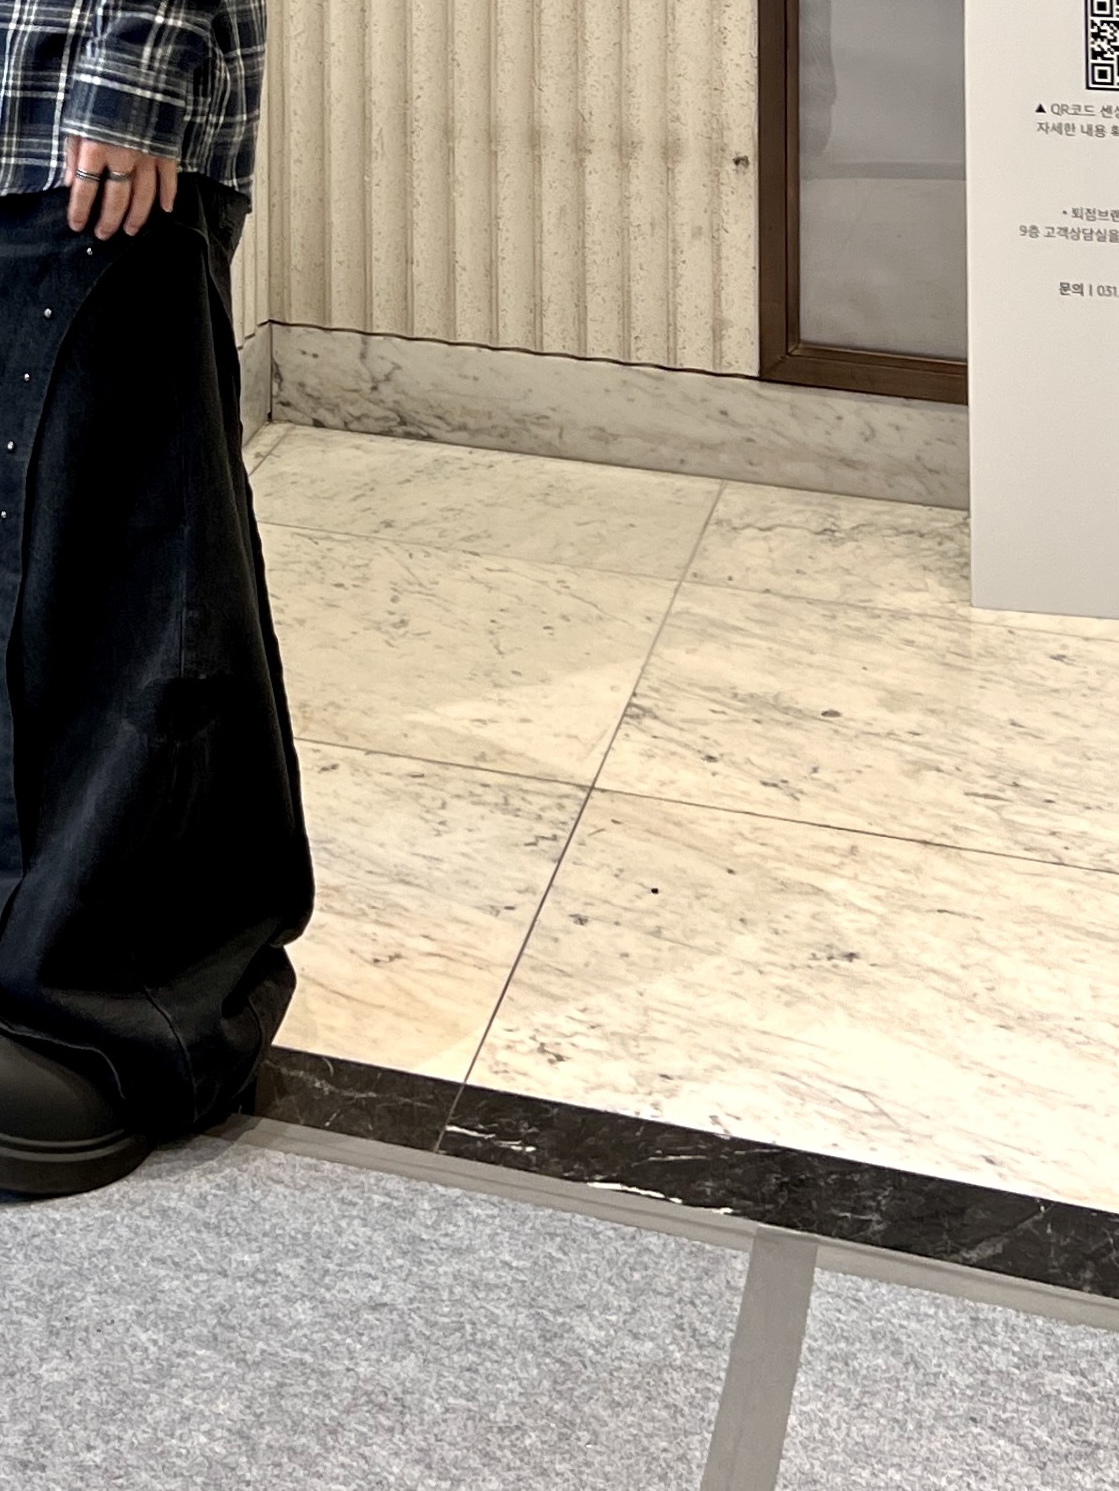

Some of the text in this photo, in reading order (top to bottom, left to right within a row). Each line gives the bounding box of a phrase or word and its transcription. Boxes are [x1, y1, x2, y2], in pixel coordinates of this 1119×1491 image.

[1050, 103, 1097, 117] QR코드
[1037, 122, 1076, 137] 자세한
[1081, 123, 1107, 139] 내용
[1019, 224, 1040, 239] 9층
[1059, 282, 1084, 297] 문의
